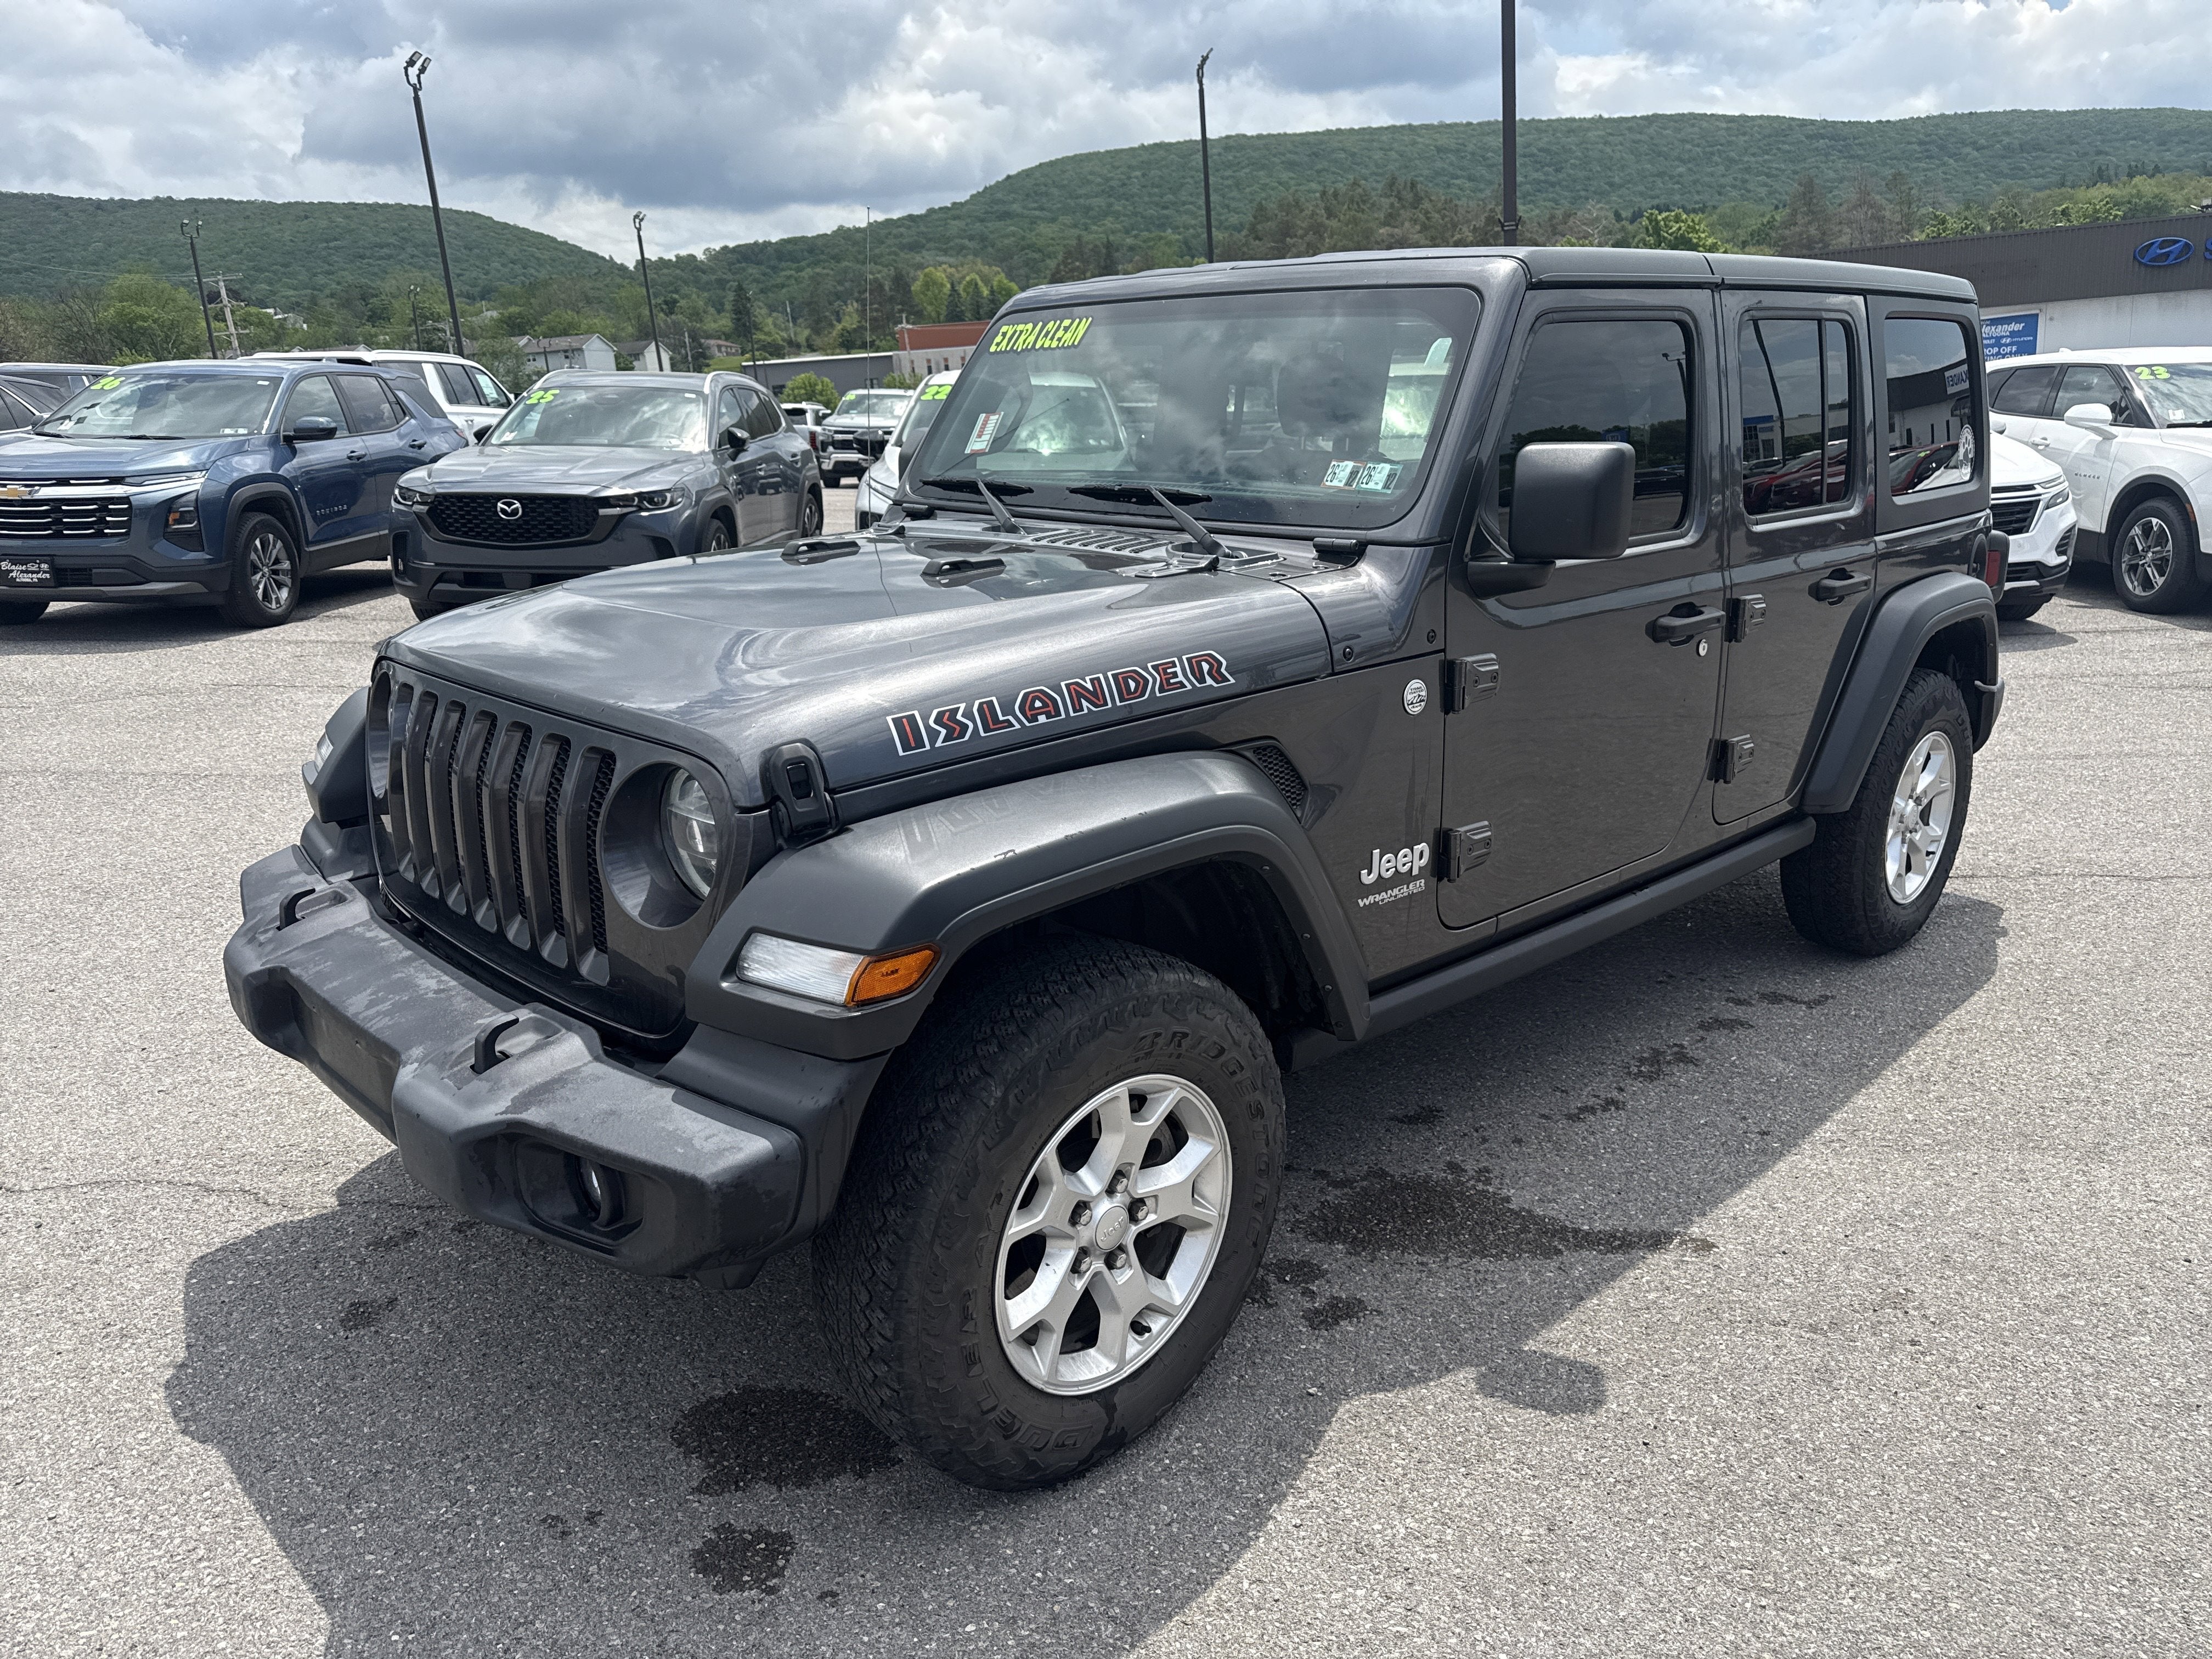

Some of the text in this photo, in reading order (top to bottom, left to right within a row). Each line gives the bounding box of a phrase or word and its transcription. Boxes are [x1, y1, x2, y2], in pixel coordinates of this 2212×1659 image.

[990, 317, 1092, 352] EXTRA CLEAN
[1982, 321, 2025, 334] lexander
[2000, 346, 2017, 354] OFF
[2134, 366, 2170, 380] 23
[91, 376, 126, 390] 26
[921, 385, 952, 400] 22
[526, 390, 560, 404] 25
[1325, 464, 1359, 487] 26 12
[1361, 466, 1397, 490] 26 12
[8, 569, 50, 578] Alexander
[886, 650, 1236, 756] ISLANDER
[1359, 842, 1430, 885] Jeep
[1357, 878, 1425, 907] WRANGLER
[1379, 886, 1425, 905] UNLIMITED
[1100, 1216, 1125, 1242] Jeep
